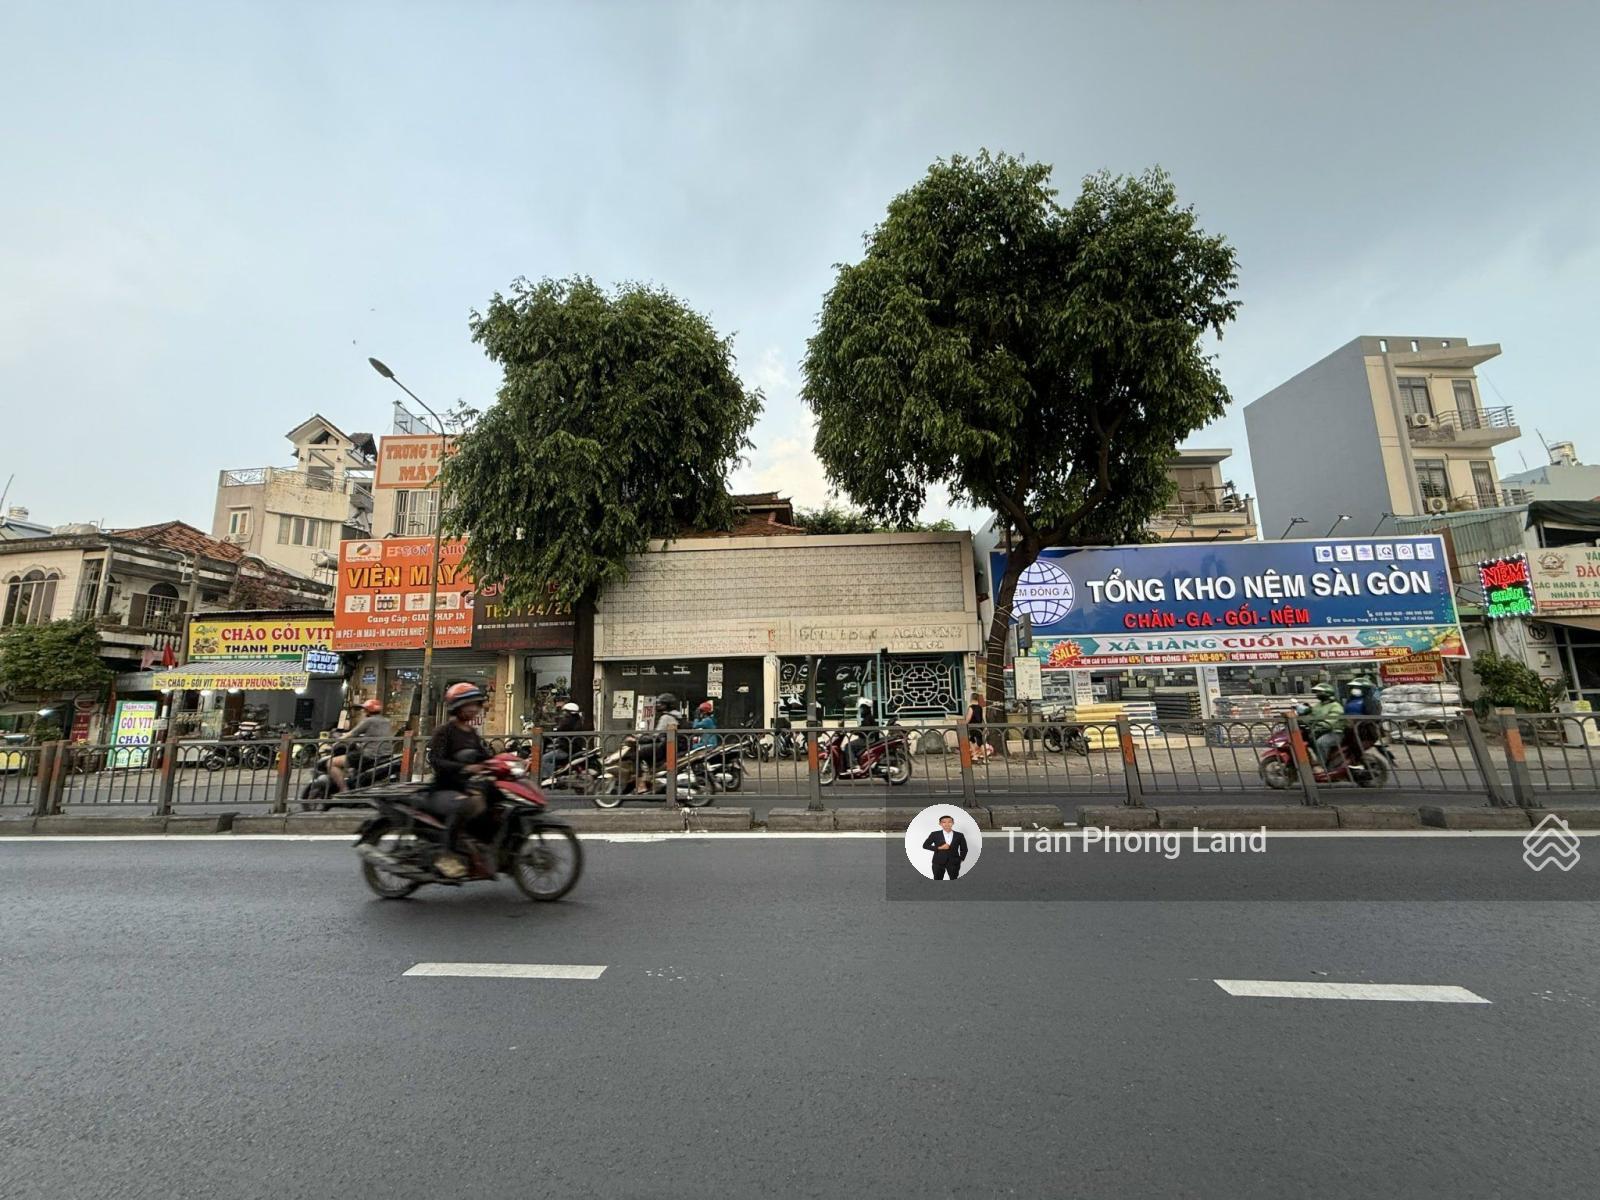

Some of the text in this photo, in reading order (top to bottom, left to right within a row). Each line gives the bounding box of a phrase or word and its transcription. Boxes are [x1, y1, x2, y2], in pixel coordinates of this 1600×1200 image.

[386, 444, 427, 459] TRUNG
[346, 558, 458, 594] VIỆN MÁY
[1482, 560, 1527, 588] NỆM
[1030, 586, 1059, 596] ĐÔNG
[1086, 564, 1432, 604] TỔNG KHO NỆM SÀI GÒN
[1124, 609, 1176, 628] CHĂN
[1186, 612, 1214, 628] GA
[1224, 604, 1258, 626] GỐI
[1271, 604, 1310, 628] NỆM
[221, 623, 333, 643] CHÁO GỎI VỊT
[225, 644, 268, 653] THANH
[1108, 633, 1348, 651] XẢ HÀNG CUỐI NĂM
[1054, 646, 1077, 661] SALE
[1296, 651, 1314, 659] 35%
[119, 732, 149, 744] CHÁO
